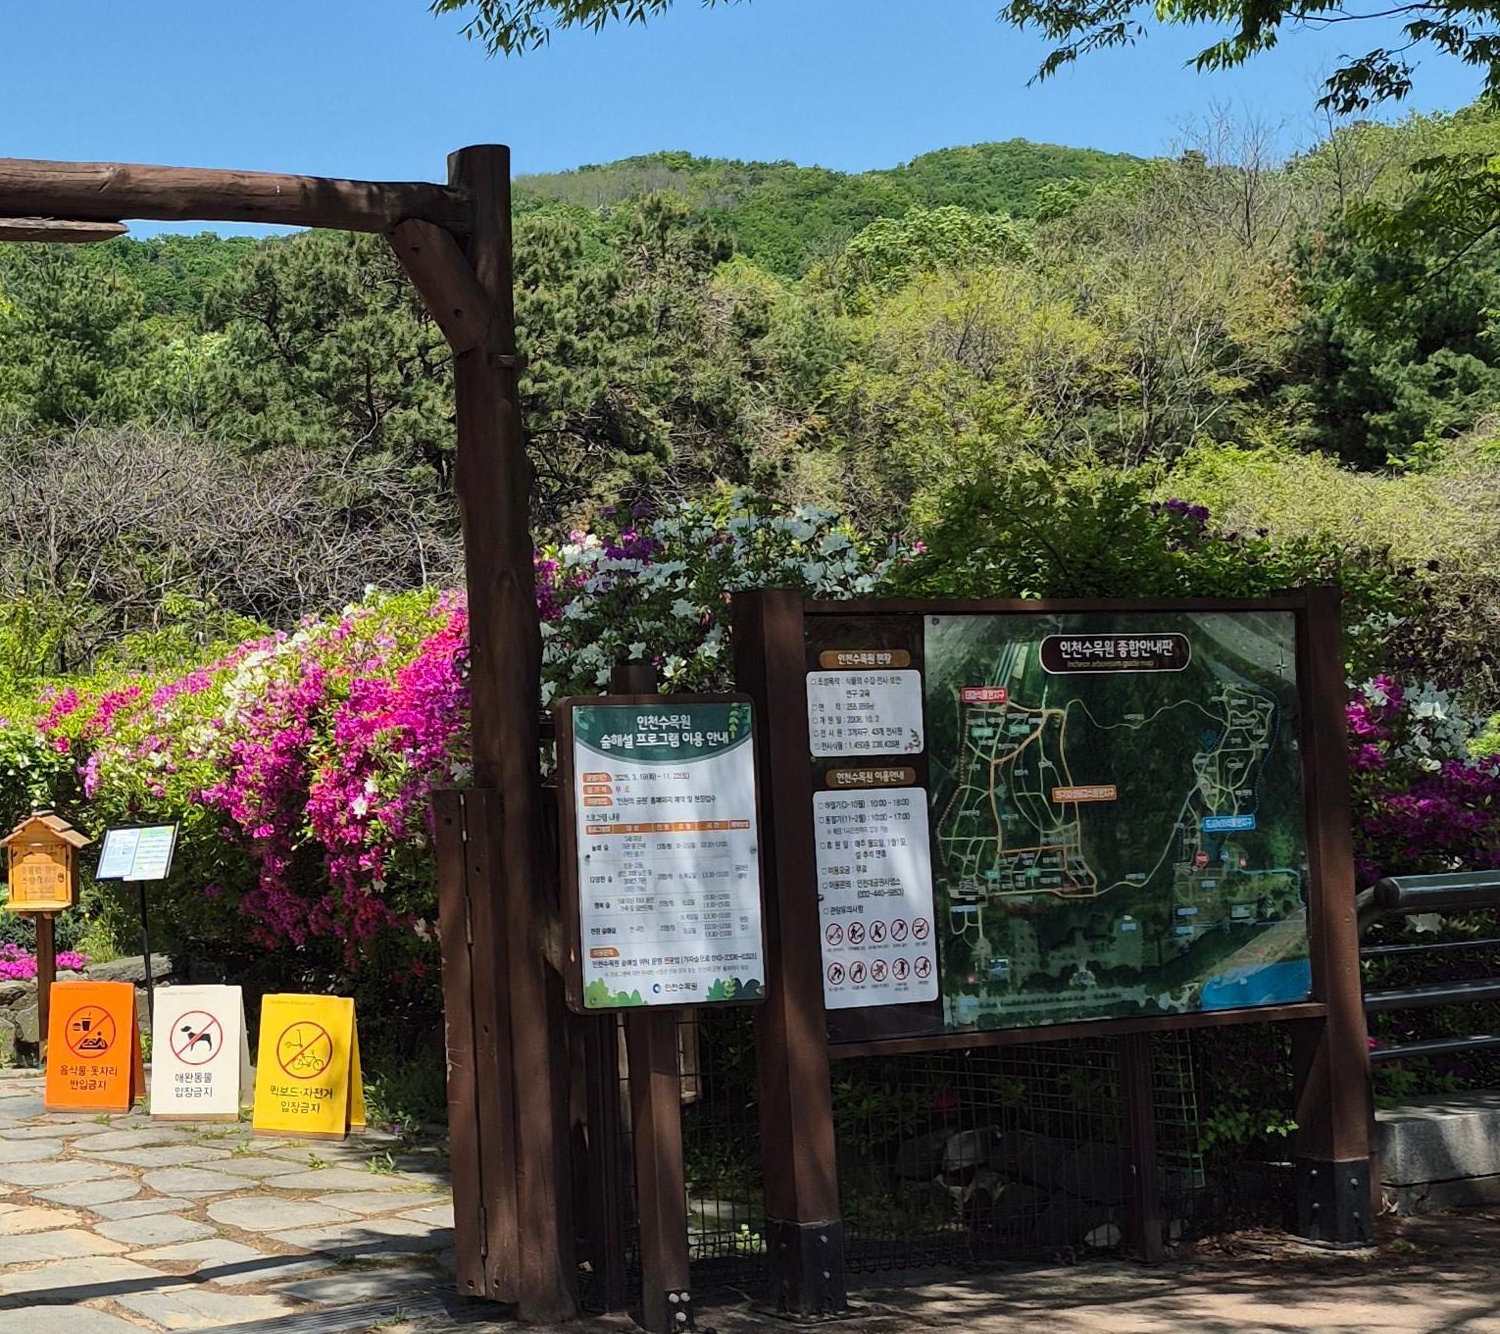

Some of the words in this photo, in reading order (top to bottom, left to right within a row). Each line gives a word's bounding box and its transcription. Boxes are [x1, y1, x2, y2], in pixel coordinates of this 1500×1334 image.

[1060, 640, 1115, 659] 인천수목원
[1117, 639, 1174, 658] 종합안내판
[837, 653, 875, 665] 인천수목원
[636, 714, 691, 731] 인천수목원
[600, 733, 634, 749] 숲해설
[636, 732, 680, 747] 프로그램
[682, 731, 704, 747] 이용
[706, 730, 729, 746] 안내
[836, 772, 873, 784] 인천수목원
[874, 770, 905, 782] 이용안내
[664, 982, 698, 993] 인천수목원
[175, 1072, 212, 1083] 애완동물
[70, 1079, 107, 1091] 반입금지
[175, 1087, 213, 1098] 입장금지
[280, 1100, 320, 1114] 입장금지
